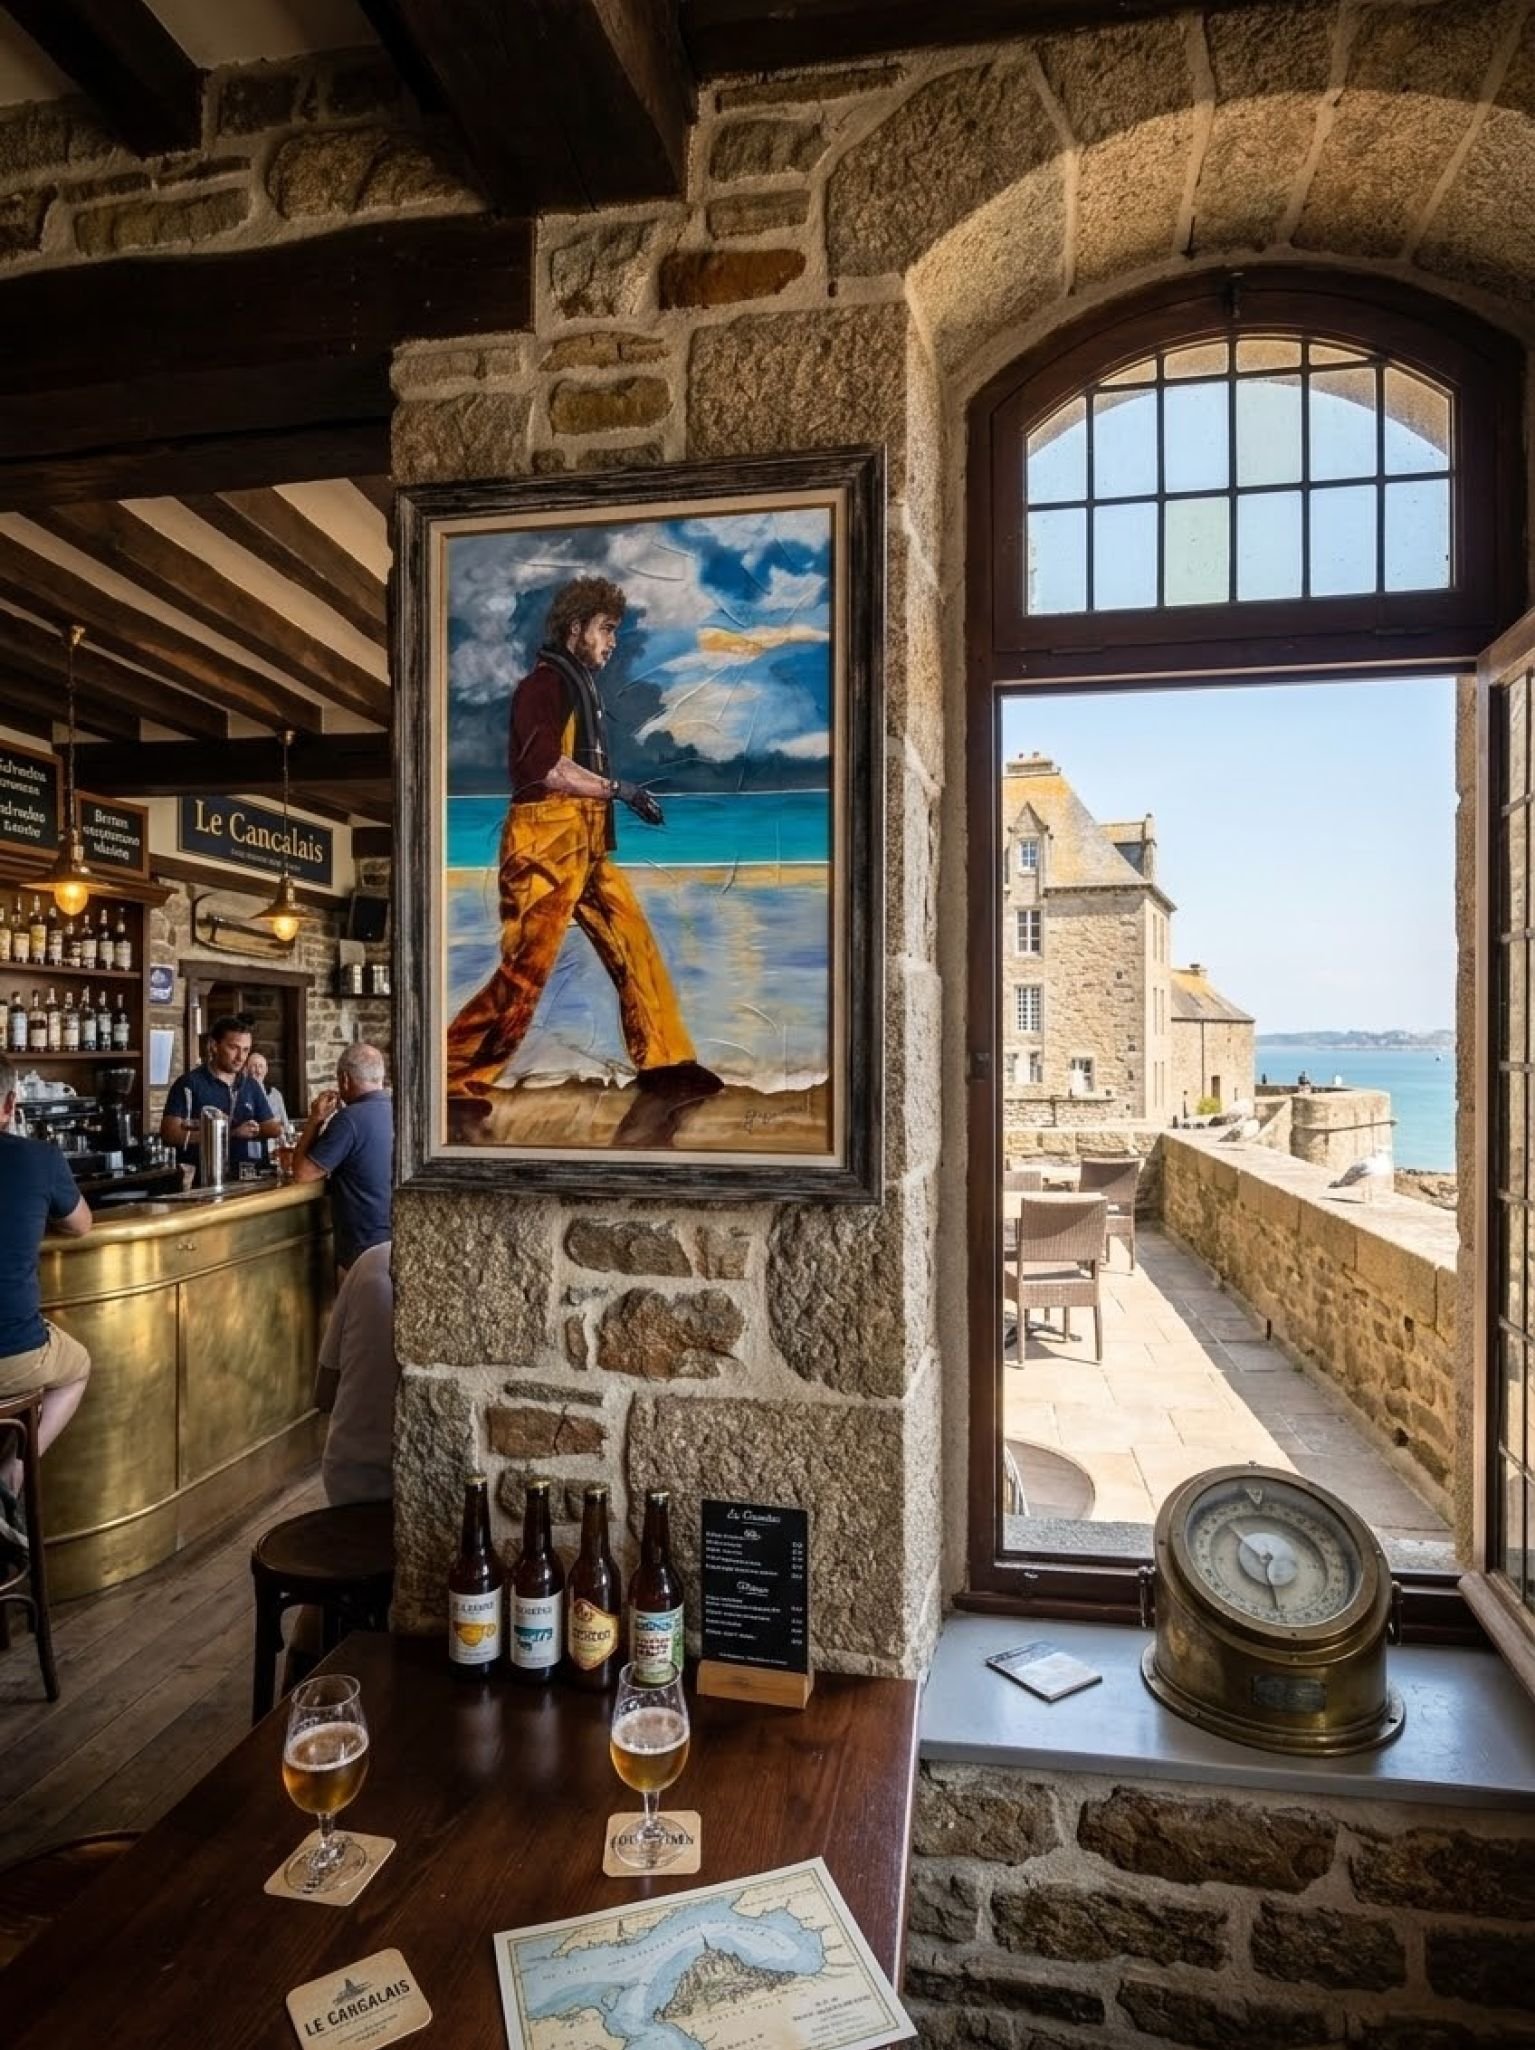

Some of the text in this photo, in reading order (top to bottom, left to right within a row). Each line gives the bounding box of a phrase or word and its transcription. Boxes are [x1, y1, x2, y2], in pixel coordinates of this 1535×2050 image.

[195, 800, 223, 837] Le
[229, 811, 323, 864] Cancalais
[304, 2018, 325, 2037] LE
